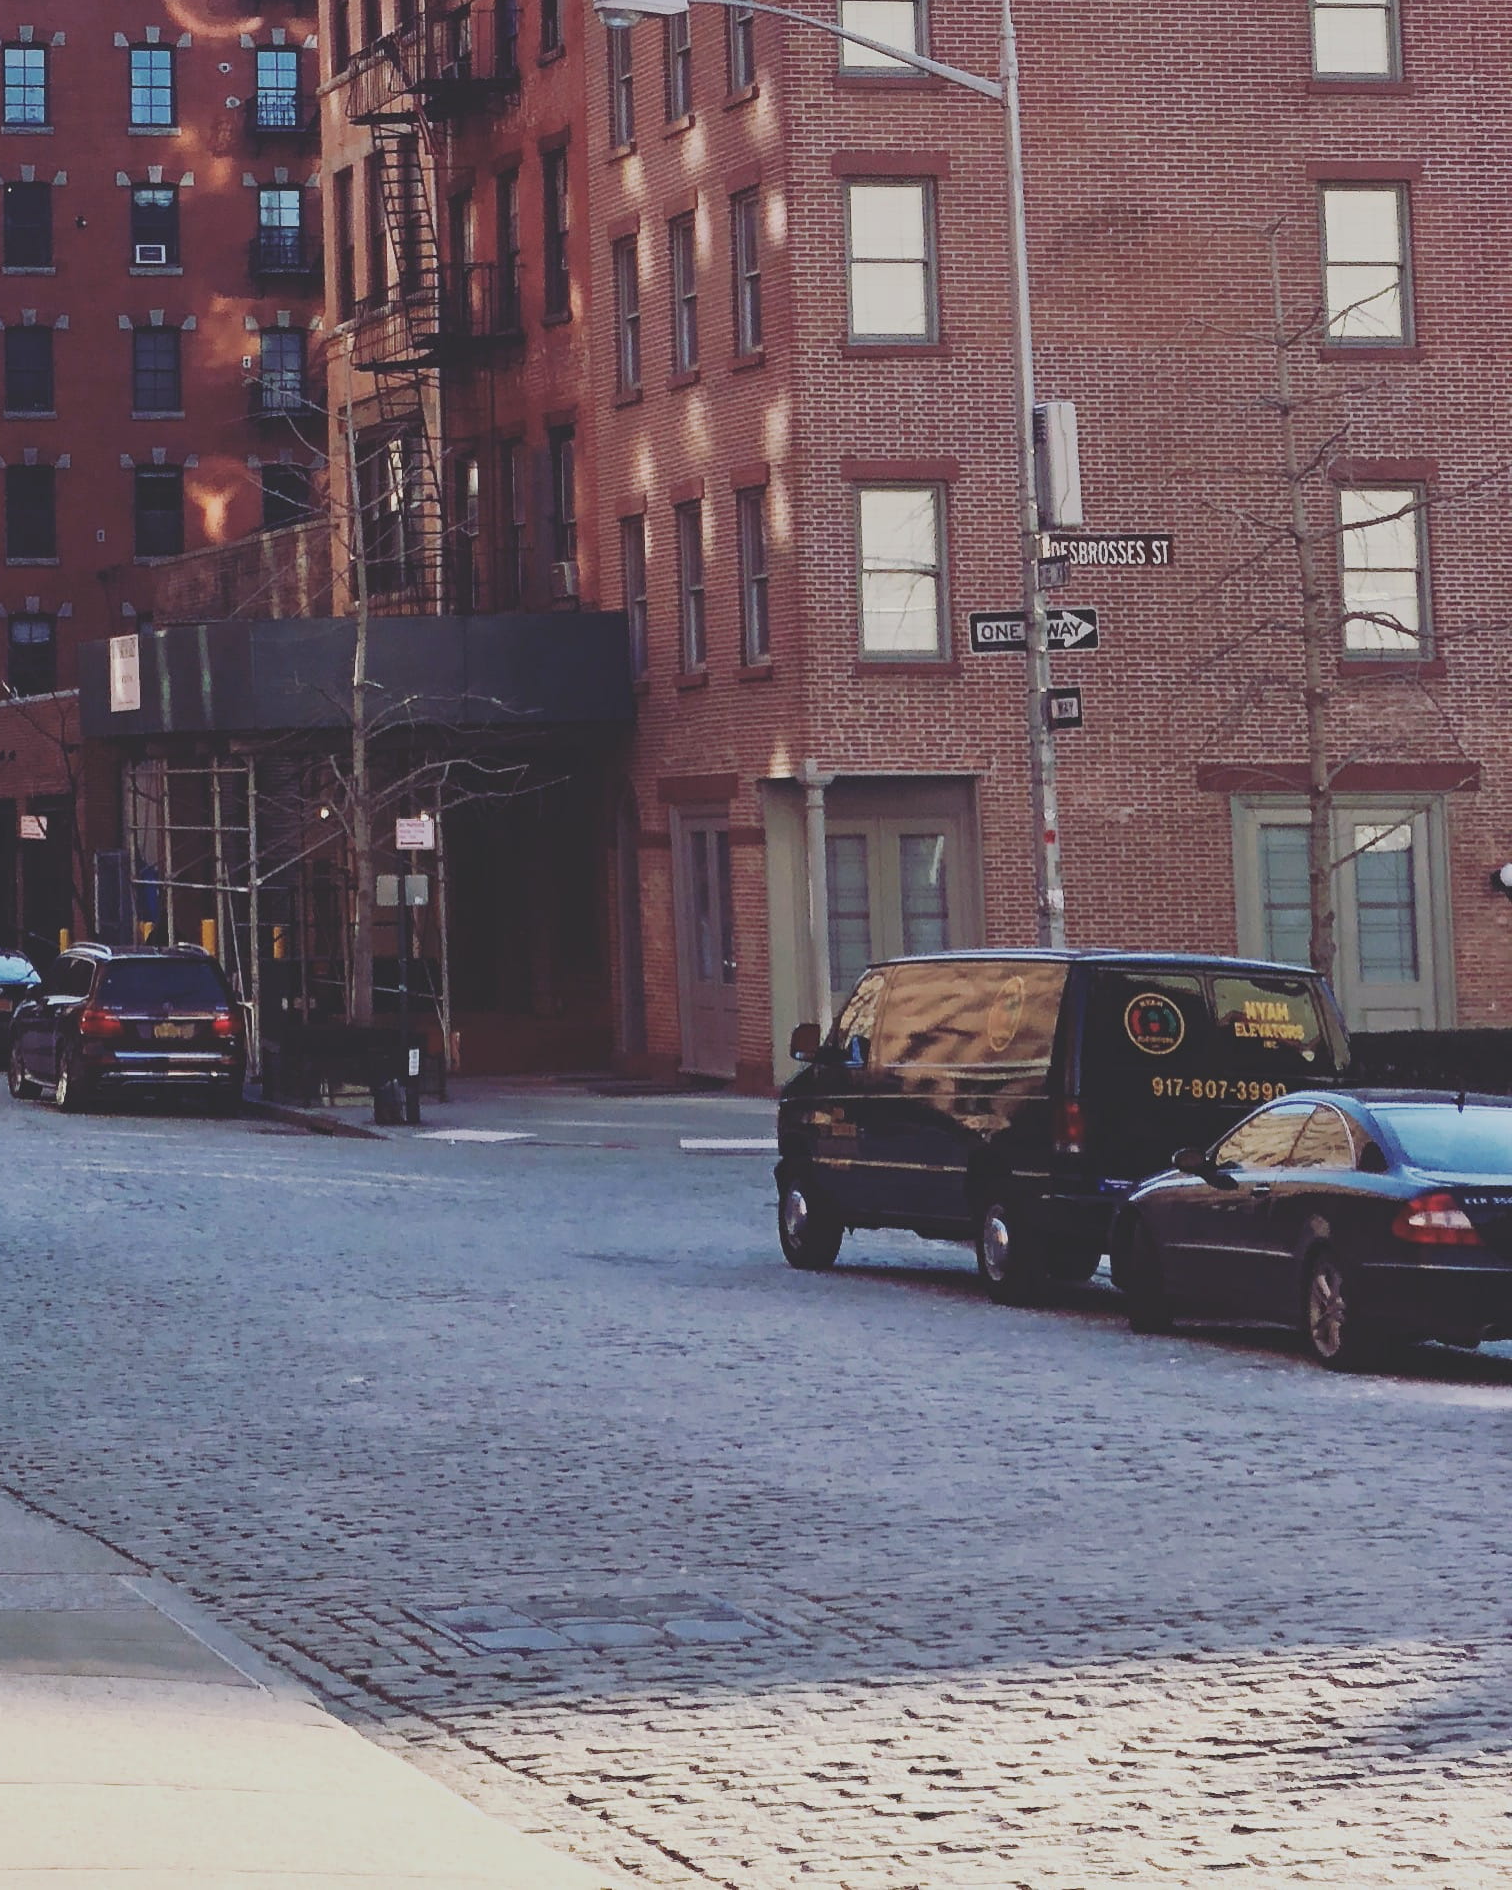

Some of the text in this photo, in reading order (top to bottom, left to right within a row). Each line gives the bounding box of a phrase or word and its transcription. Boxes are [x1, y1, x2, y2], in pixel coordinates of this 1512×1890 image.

[1152, 540, 1169, 564] ST
[981, 622, 1083, 640] ONE WAY
[1234, 1022, 1305, 1040] ELEVATORS
[1151, 1076, 1287, 1101] 917-807-3990
